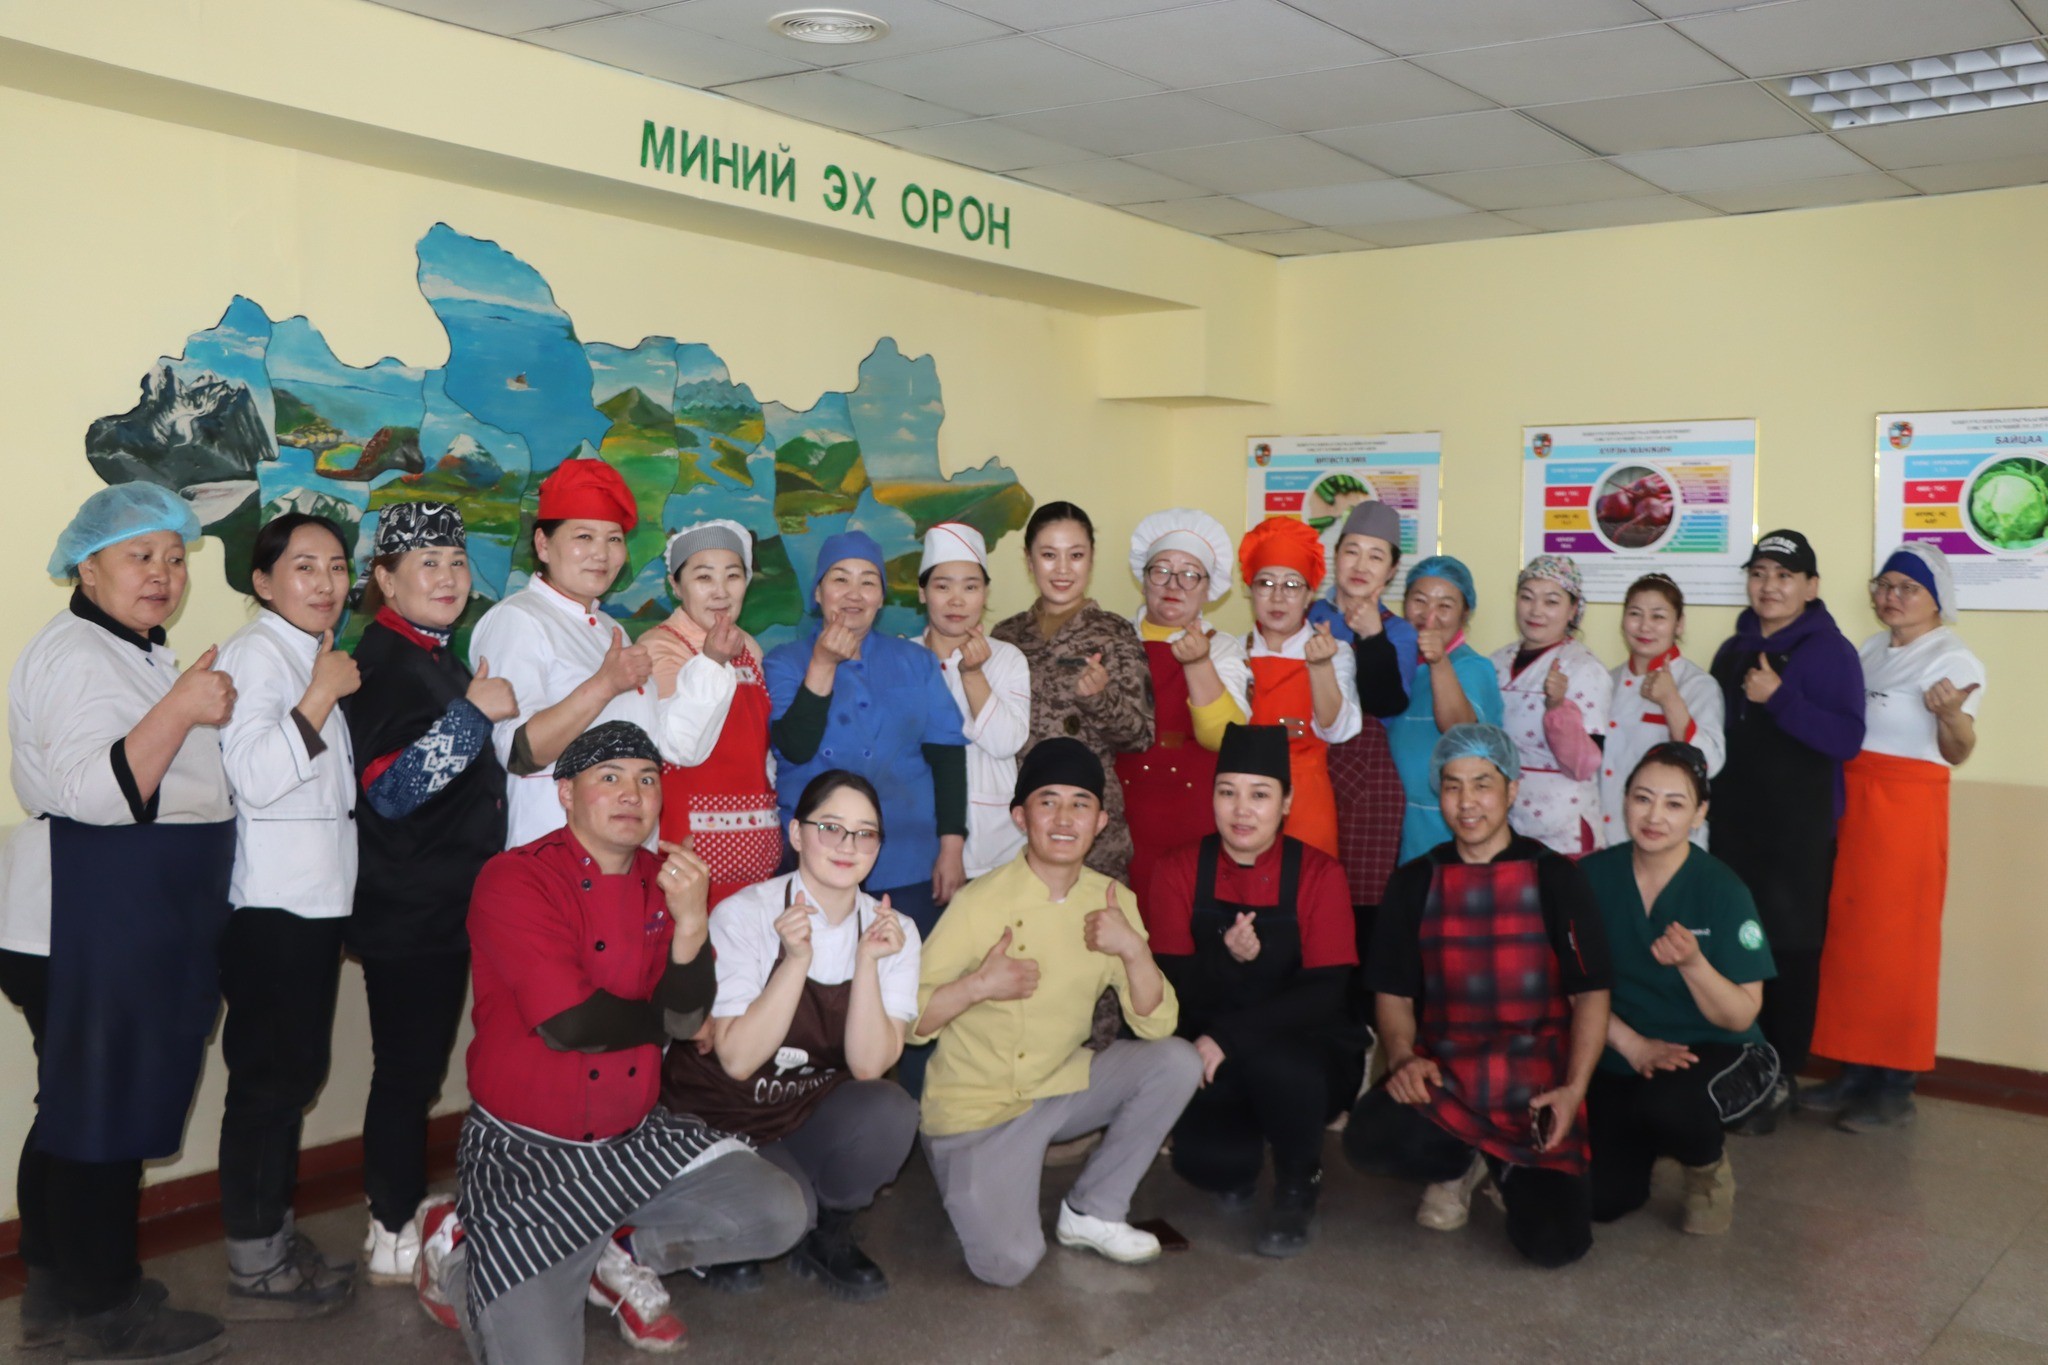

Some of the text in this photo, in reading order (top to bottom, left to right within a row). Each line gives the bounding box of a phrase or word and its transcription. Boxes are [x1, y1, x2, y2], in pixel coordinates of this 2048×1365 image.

[640, 119, 1011, 250] МИНИЙ ЭХ ОРОН
[1994, 434, 2043, 445] БАЙЦАА
